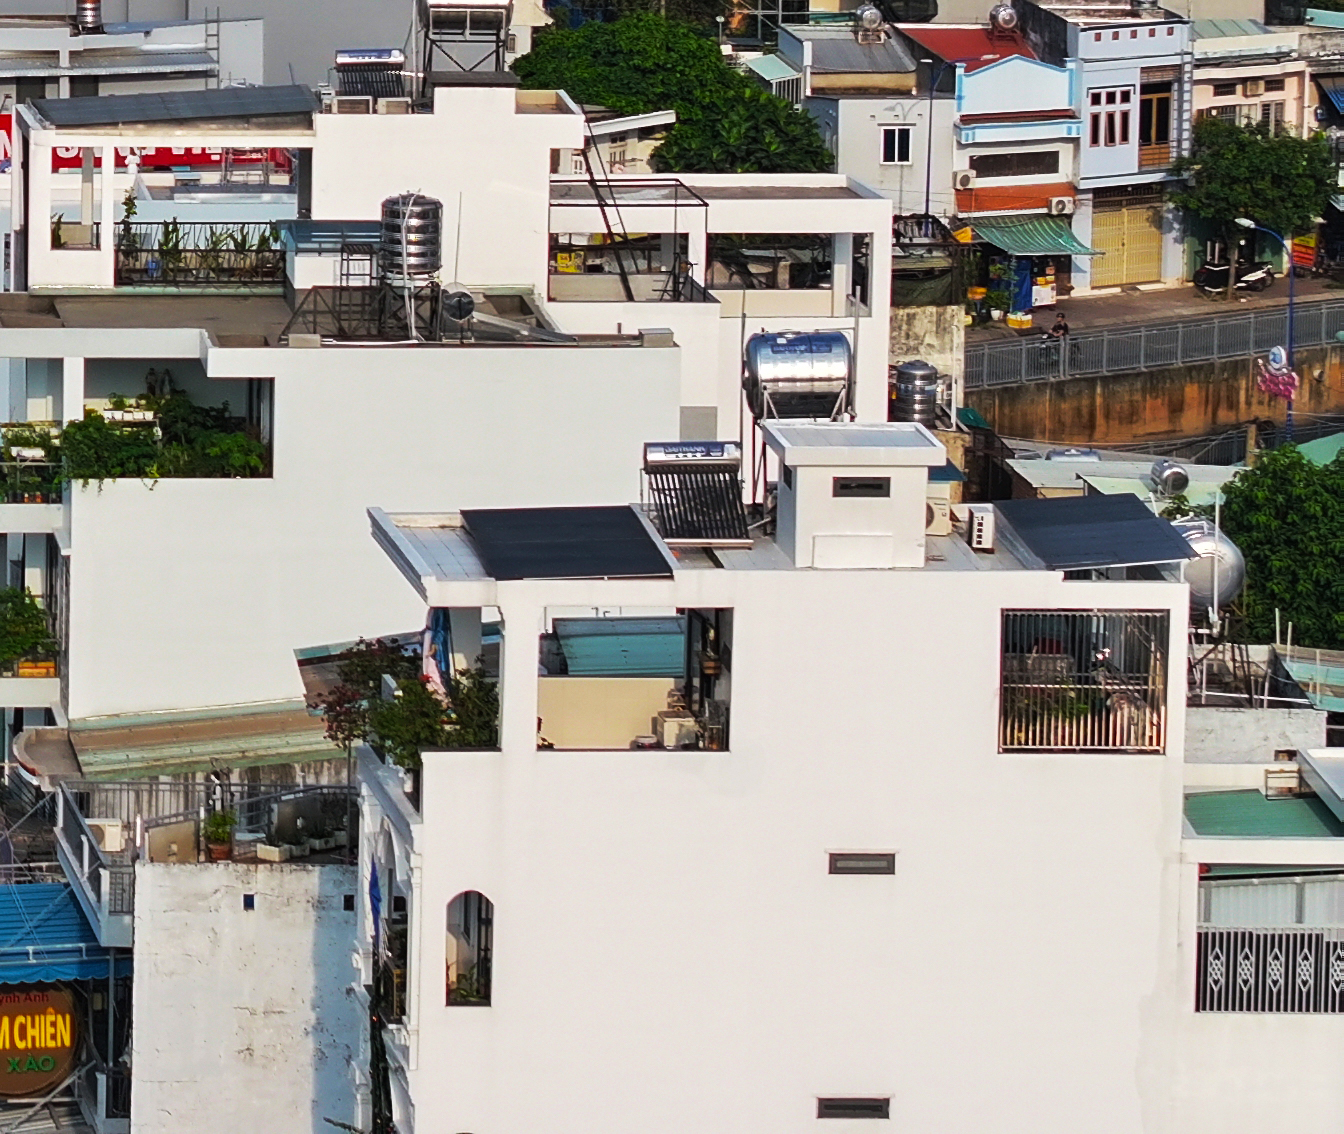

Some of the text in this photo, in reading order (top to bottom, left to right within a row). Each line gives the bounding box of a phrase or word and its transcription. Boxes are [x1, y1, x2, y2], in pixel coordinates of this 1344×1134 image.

[23, 992, 49, 1003] Anh
[13, 1007, 71, 1049] CHIÊN
[7, 1052, 55, 1073] XÀO
